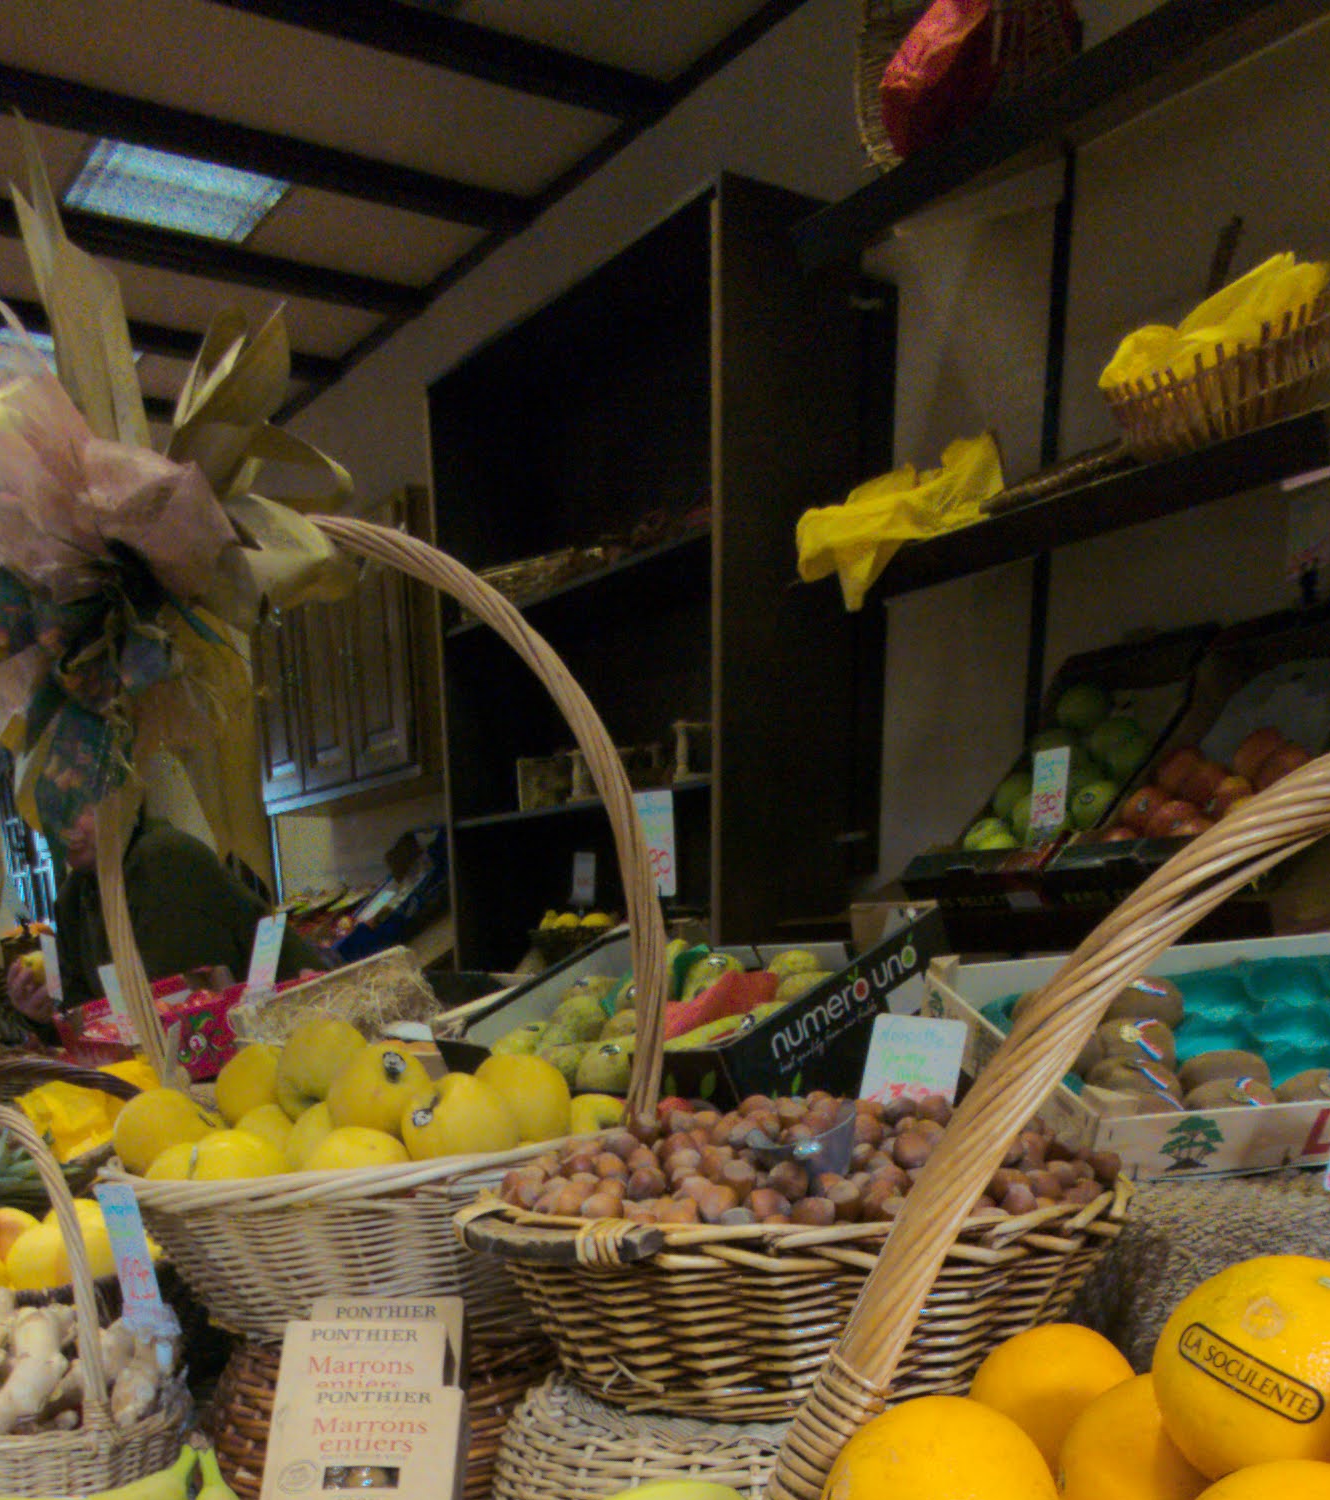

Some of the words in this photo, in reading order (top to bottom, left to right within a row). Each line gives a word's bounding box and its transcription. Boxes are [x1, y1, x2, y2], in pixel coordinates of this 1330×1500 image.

[771, 977, 870, 1060] numero
[872, 945, 918, 988] uno
[336, 1305, 437, 1320] PONTHIER
[311, 1328, 418, 1343] PONTHIER
[308, 1355, 415, 1376] Marrons
[1184, 1331, 1202, 1355] LA
[1204, 1345, 1313, 1415] SOCULENTE
[317, 1391, 432, 1405] PONTHIER
[312, 1416, 429, 1436] Marrons
[320, 1436, 414, 1453] entiers
